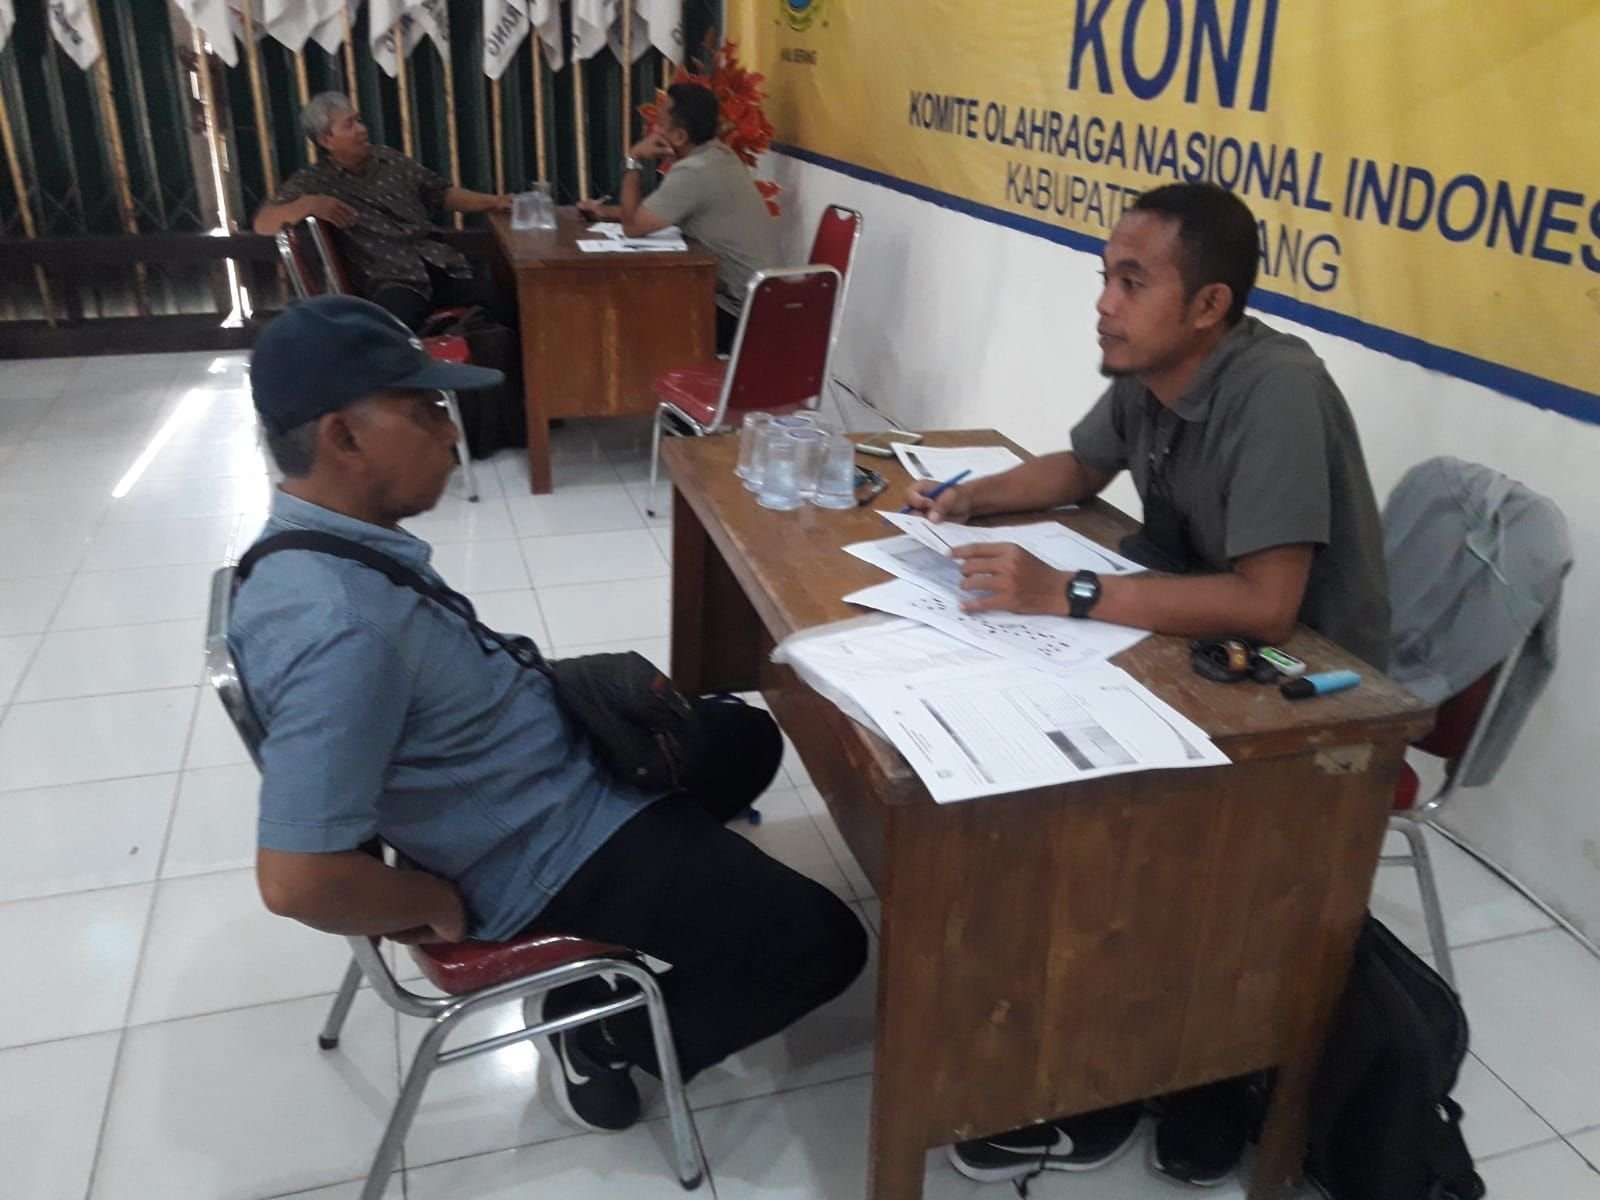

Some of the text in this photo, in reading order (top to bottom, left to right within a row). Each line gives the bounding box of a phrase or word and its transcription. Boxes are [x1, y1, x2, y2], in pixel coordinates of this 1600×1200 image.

[1067, 0, 1279, 112] KONI
[909, 89, 980, 140] KOMITE
[984, 101, 1127, 169] OLAHRAGA
[1134, 123, 1332, 213] NASIONAL
[1006, 160, 1341, 292] KABUPATE ANG
